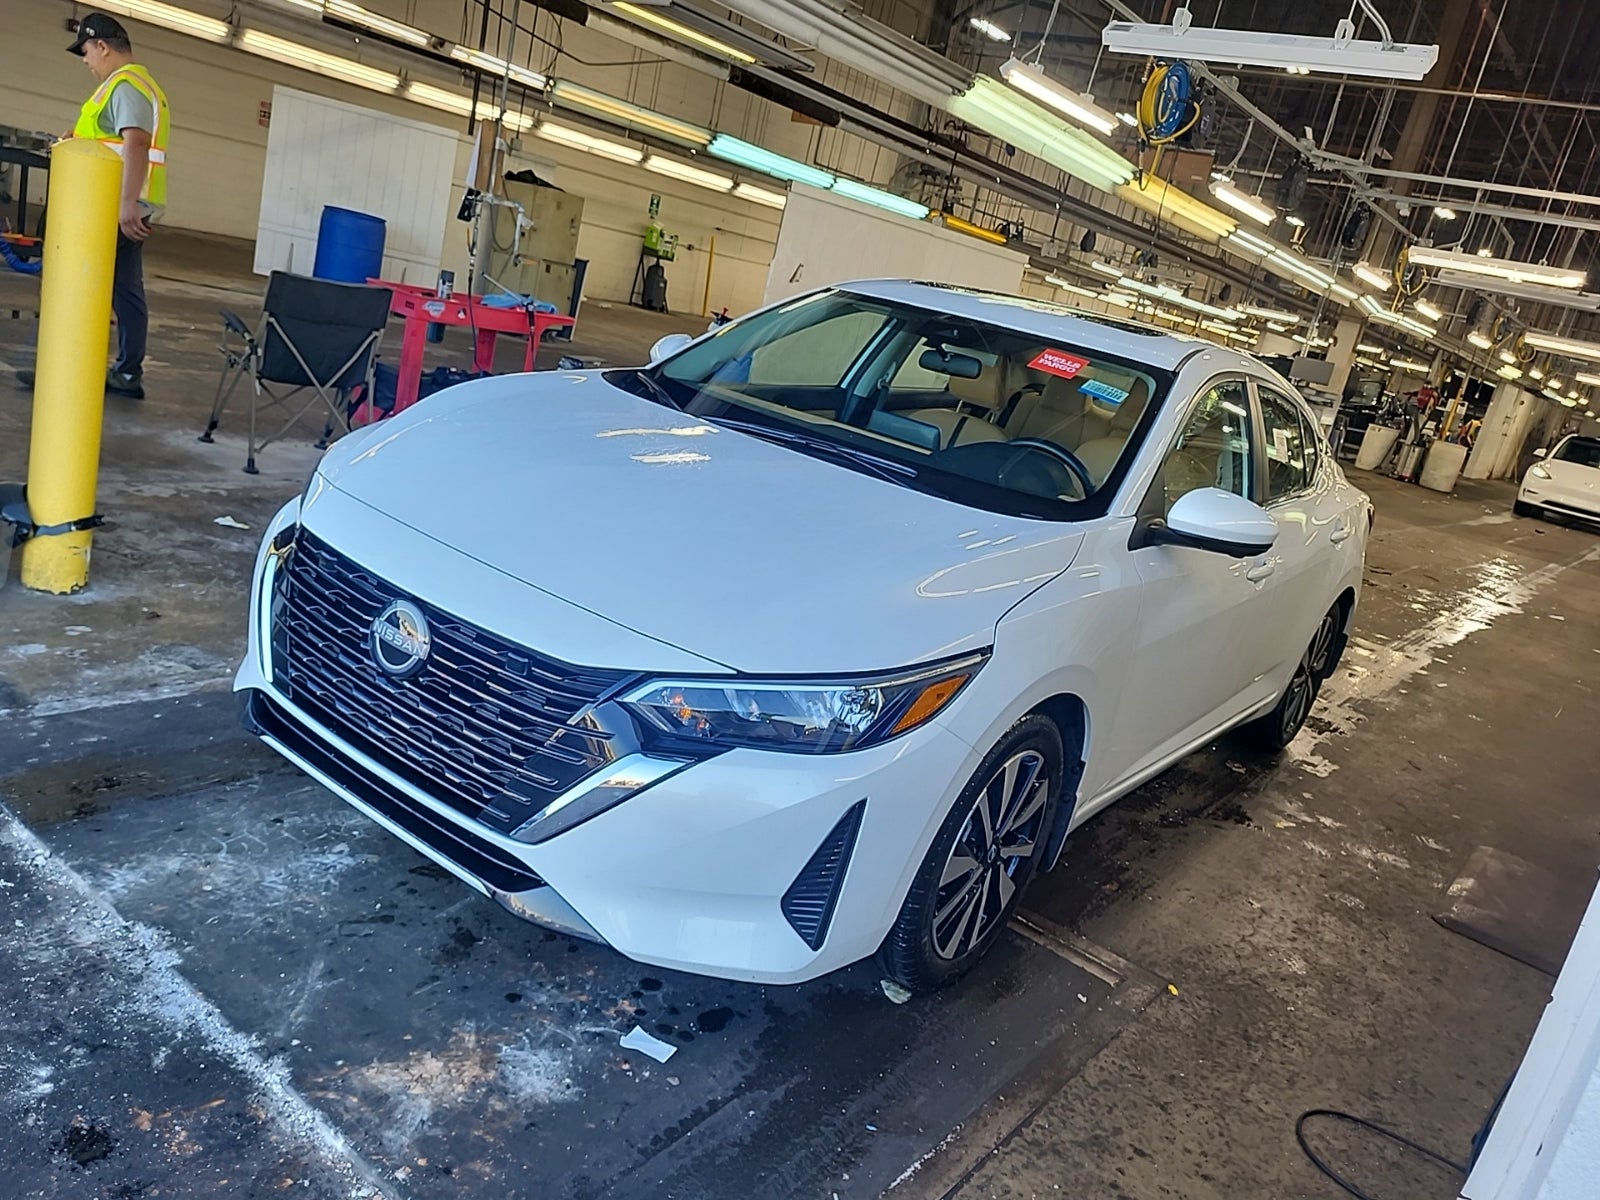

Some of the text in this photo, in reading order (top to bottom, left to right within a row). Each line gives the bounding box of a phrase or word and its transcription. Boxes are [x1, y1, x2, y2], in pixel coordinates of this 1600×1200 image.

[1038, 358, 1077, 373] FARGO
[1043, 353, 1081, 369] WELLS
[373, 619, 426, 658] NISSAN
